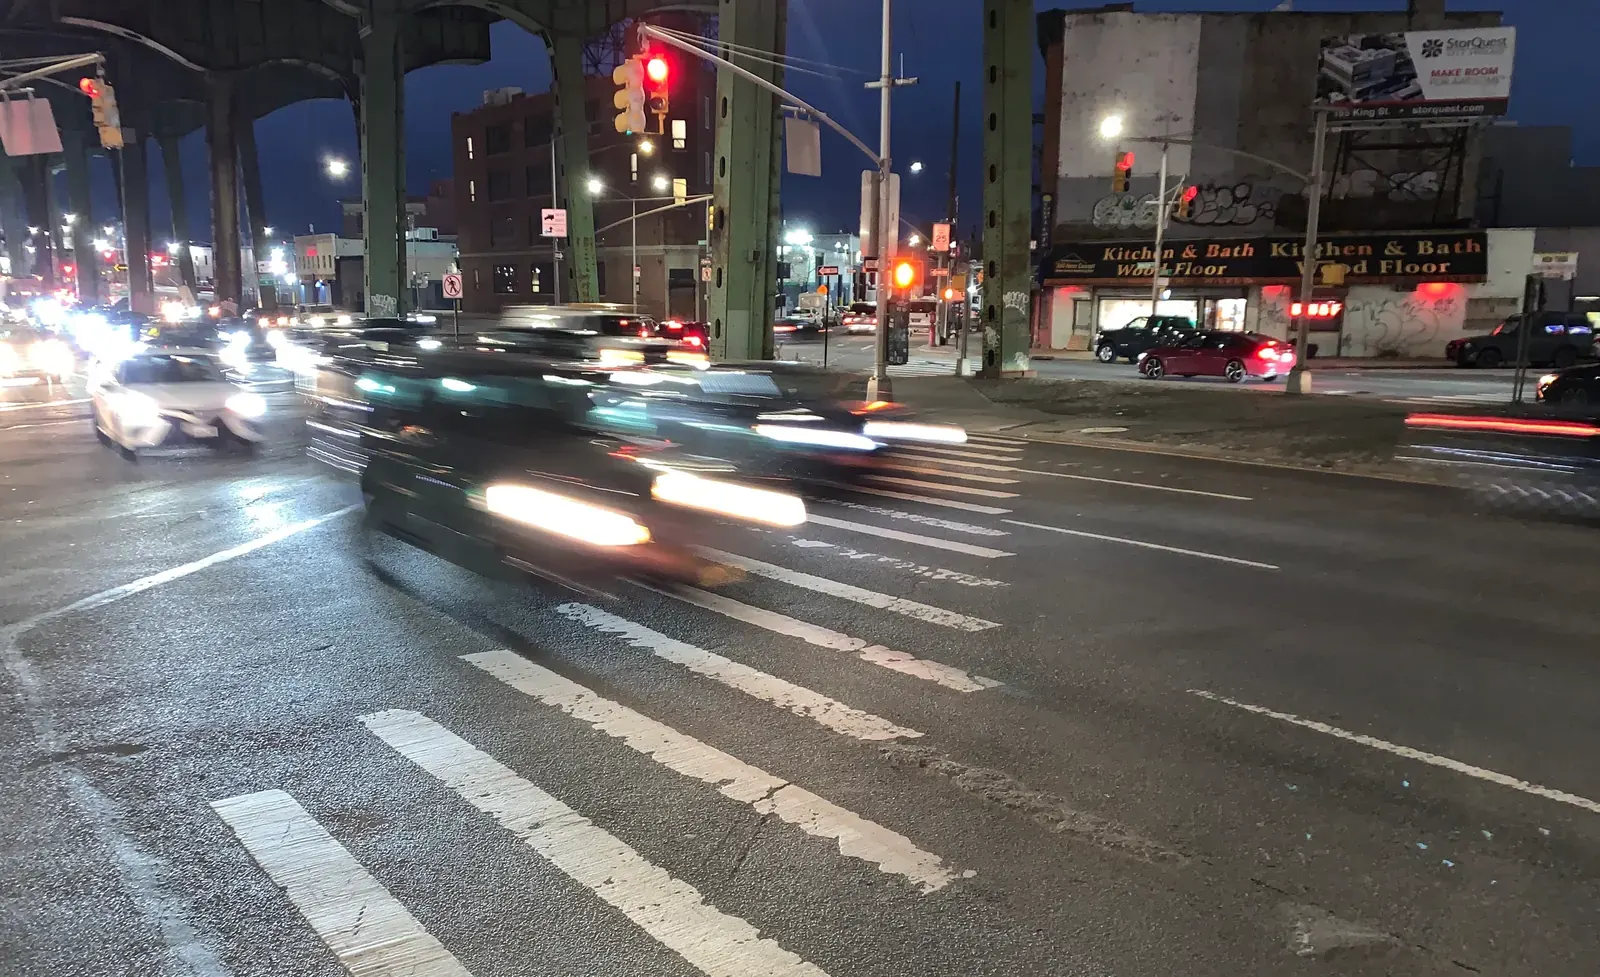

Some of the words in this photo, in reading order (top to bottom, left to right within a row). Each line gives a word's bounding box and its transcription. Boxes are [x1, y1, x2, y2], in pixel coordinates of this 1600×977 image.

[1446, 36, 1507, 49] StorQuest
[1431, 68, 1461, 77] MAKE
[1464, 66, 1499, 76] ROOM
[1352, 107, 1376, 118] King
[1411, 104, 1485, 115] storquest.com
[935, 234, 947, 243] 25
[1181, 243, 1198, 258] &
[1205, 242, 1255, 258] Bath
[1384, 240, 1407, 256] &
[1417, 238, 1482, 255] Bath
[1173, 261, 1228, 276] Floor
[1379, 258, 1451, 275] Floor
